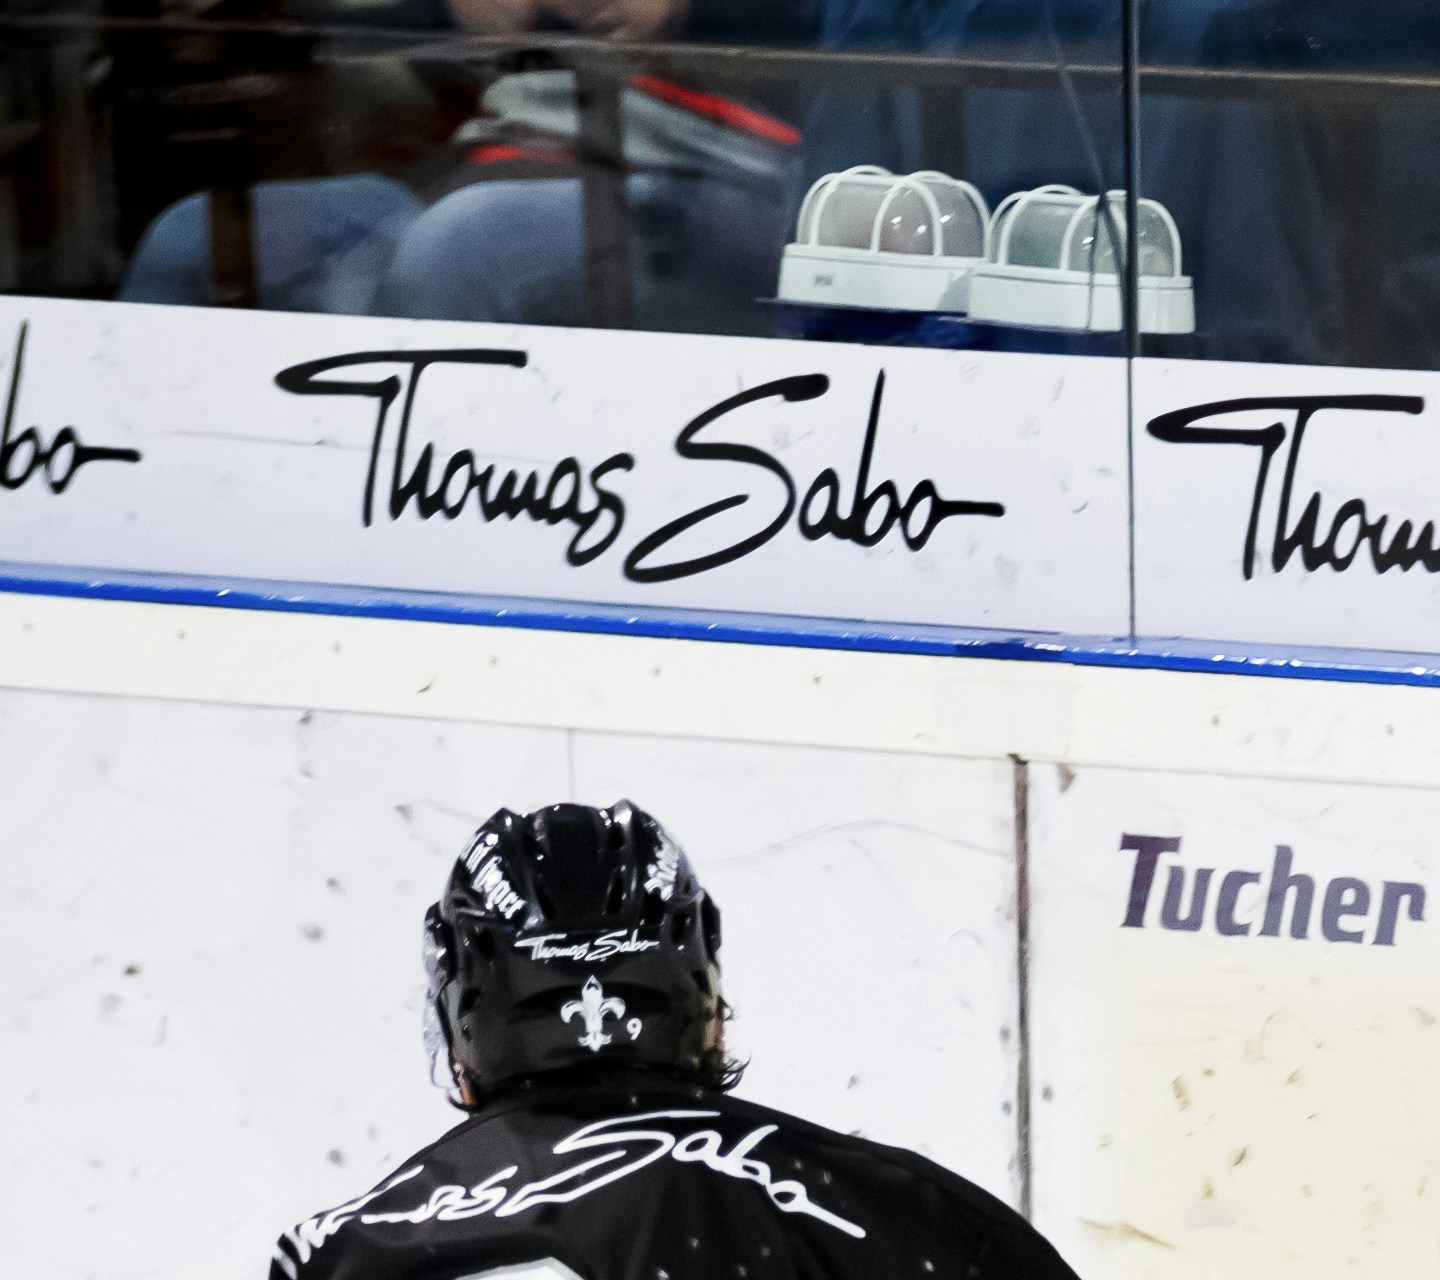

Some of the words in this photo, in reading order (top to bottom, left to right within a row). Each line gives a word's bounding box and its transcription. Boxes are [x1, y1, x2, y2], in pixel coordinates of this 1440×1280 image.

[274, 348, 634, 567] Thomas
[623, 369, 1006, 584] Sabo
[513, 932, 589, 962] Thomas
[584, 928, 660, 961] Sabo
[1120, 833, 1425, 946] Tucher
[625, 1017, 643, 1041] 9
[496, 1109, 867, 1239] Sabo
